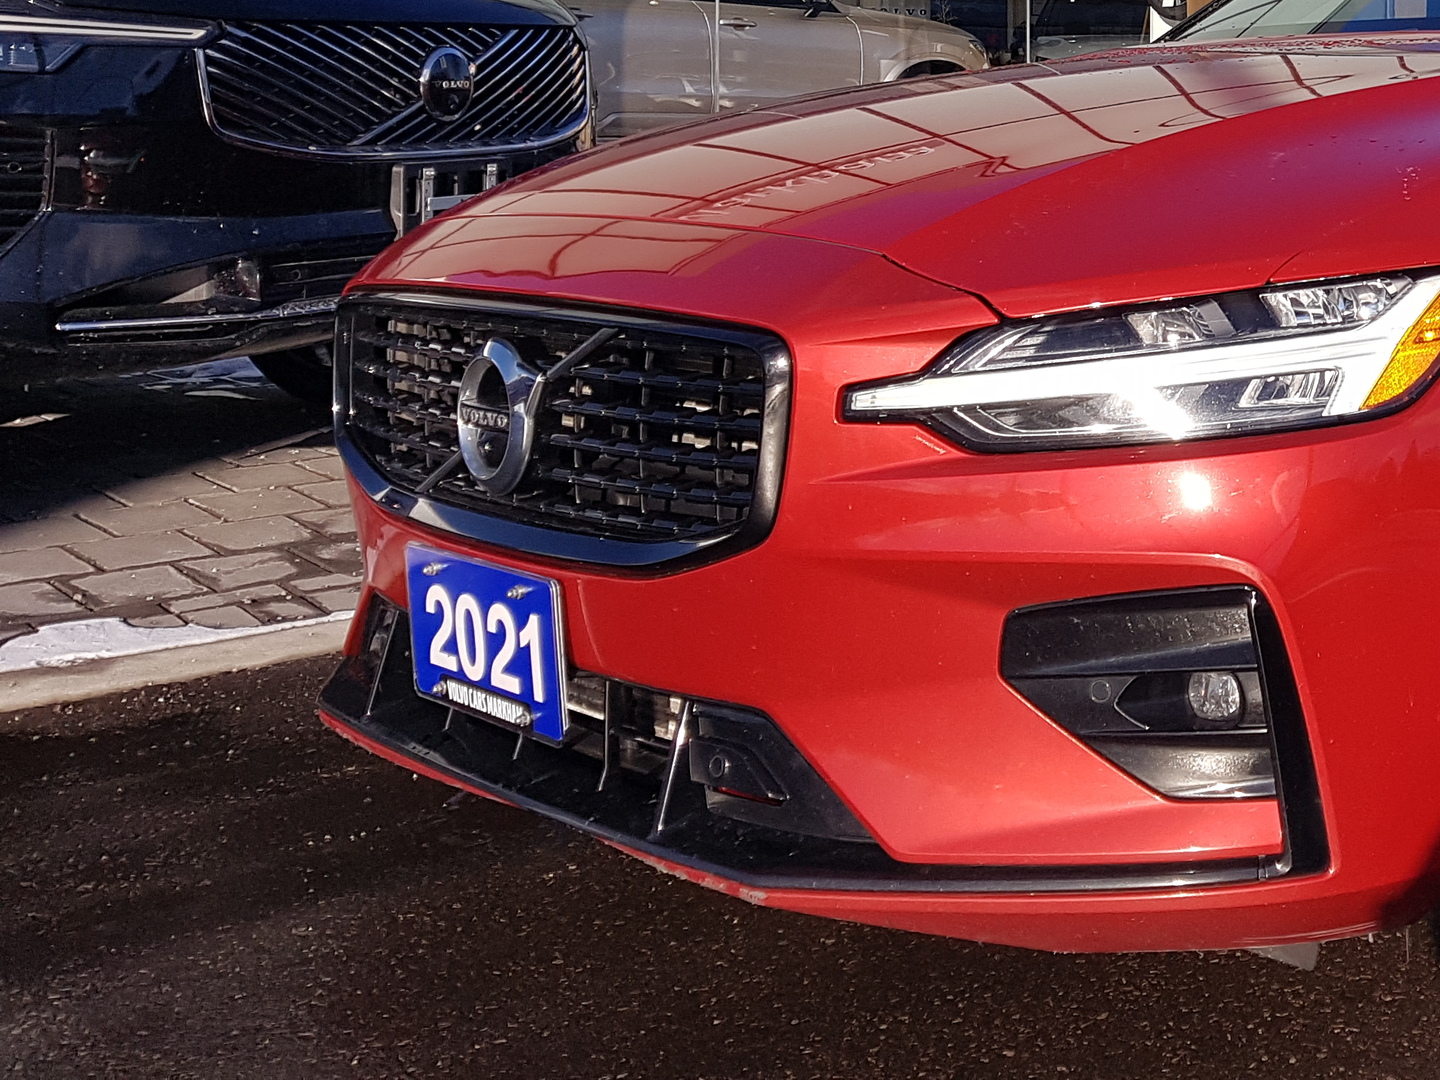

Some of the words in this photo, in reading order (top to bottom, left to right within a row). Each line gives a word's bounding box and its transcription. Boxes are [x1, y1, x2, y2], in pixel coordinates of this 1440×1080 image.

[433, 80, 469, 88] VOLVO
[462, 407, 507, 427] VOLVO
[426, 584, 544, 703] 2021
[447, 679, 469, 706] VOLVO
[469, 689, 487, 713] CARS
[487, 695, 523, 724] MARKHAM
